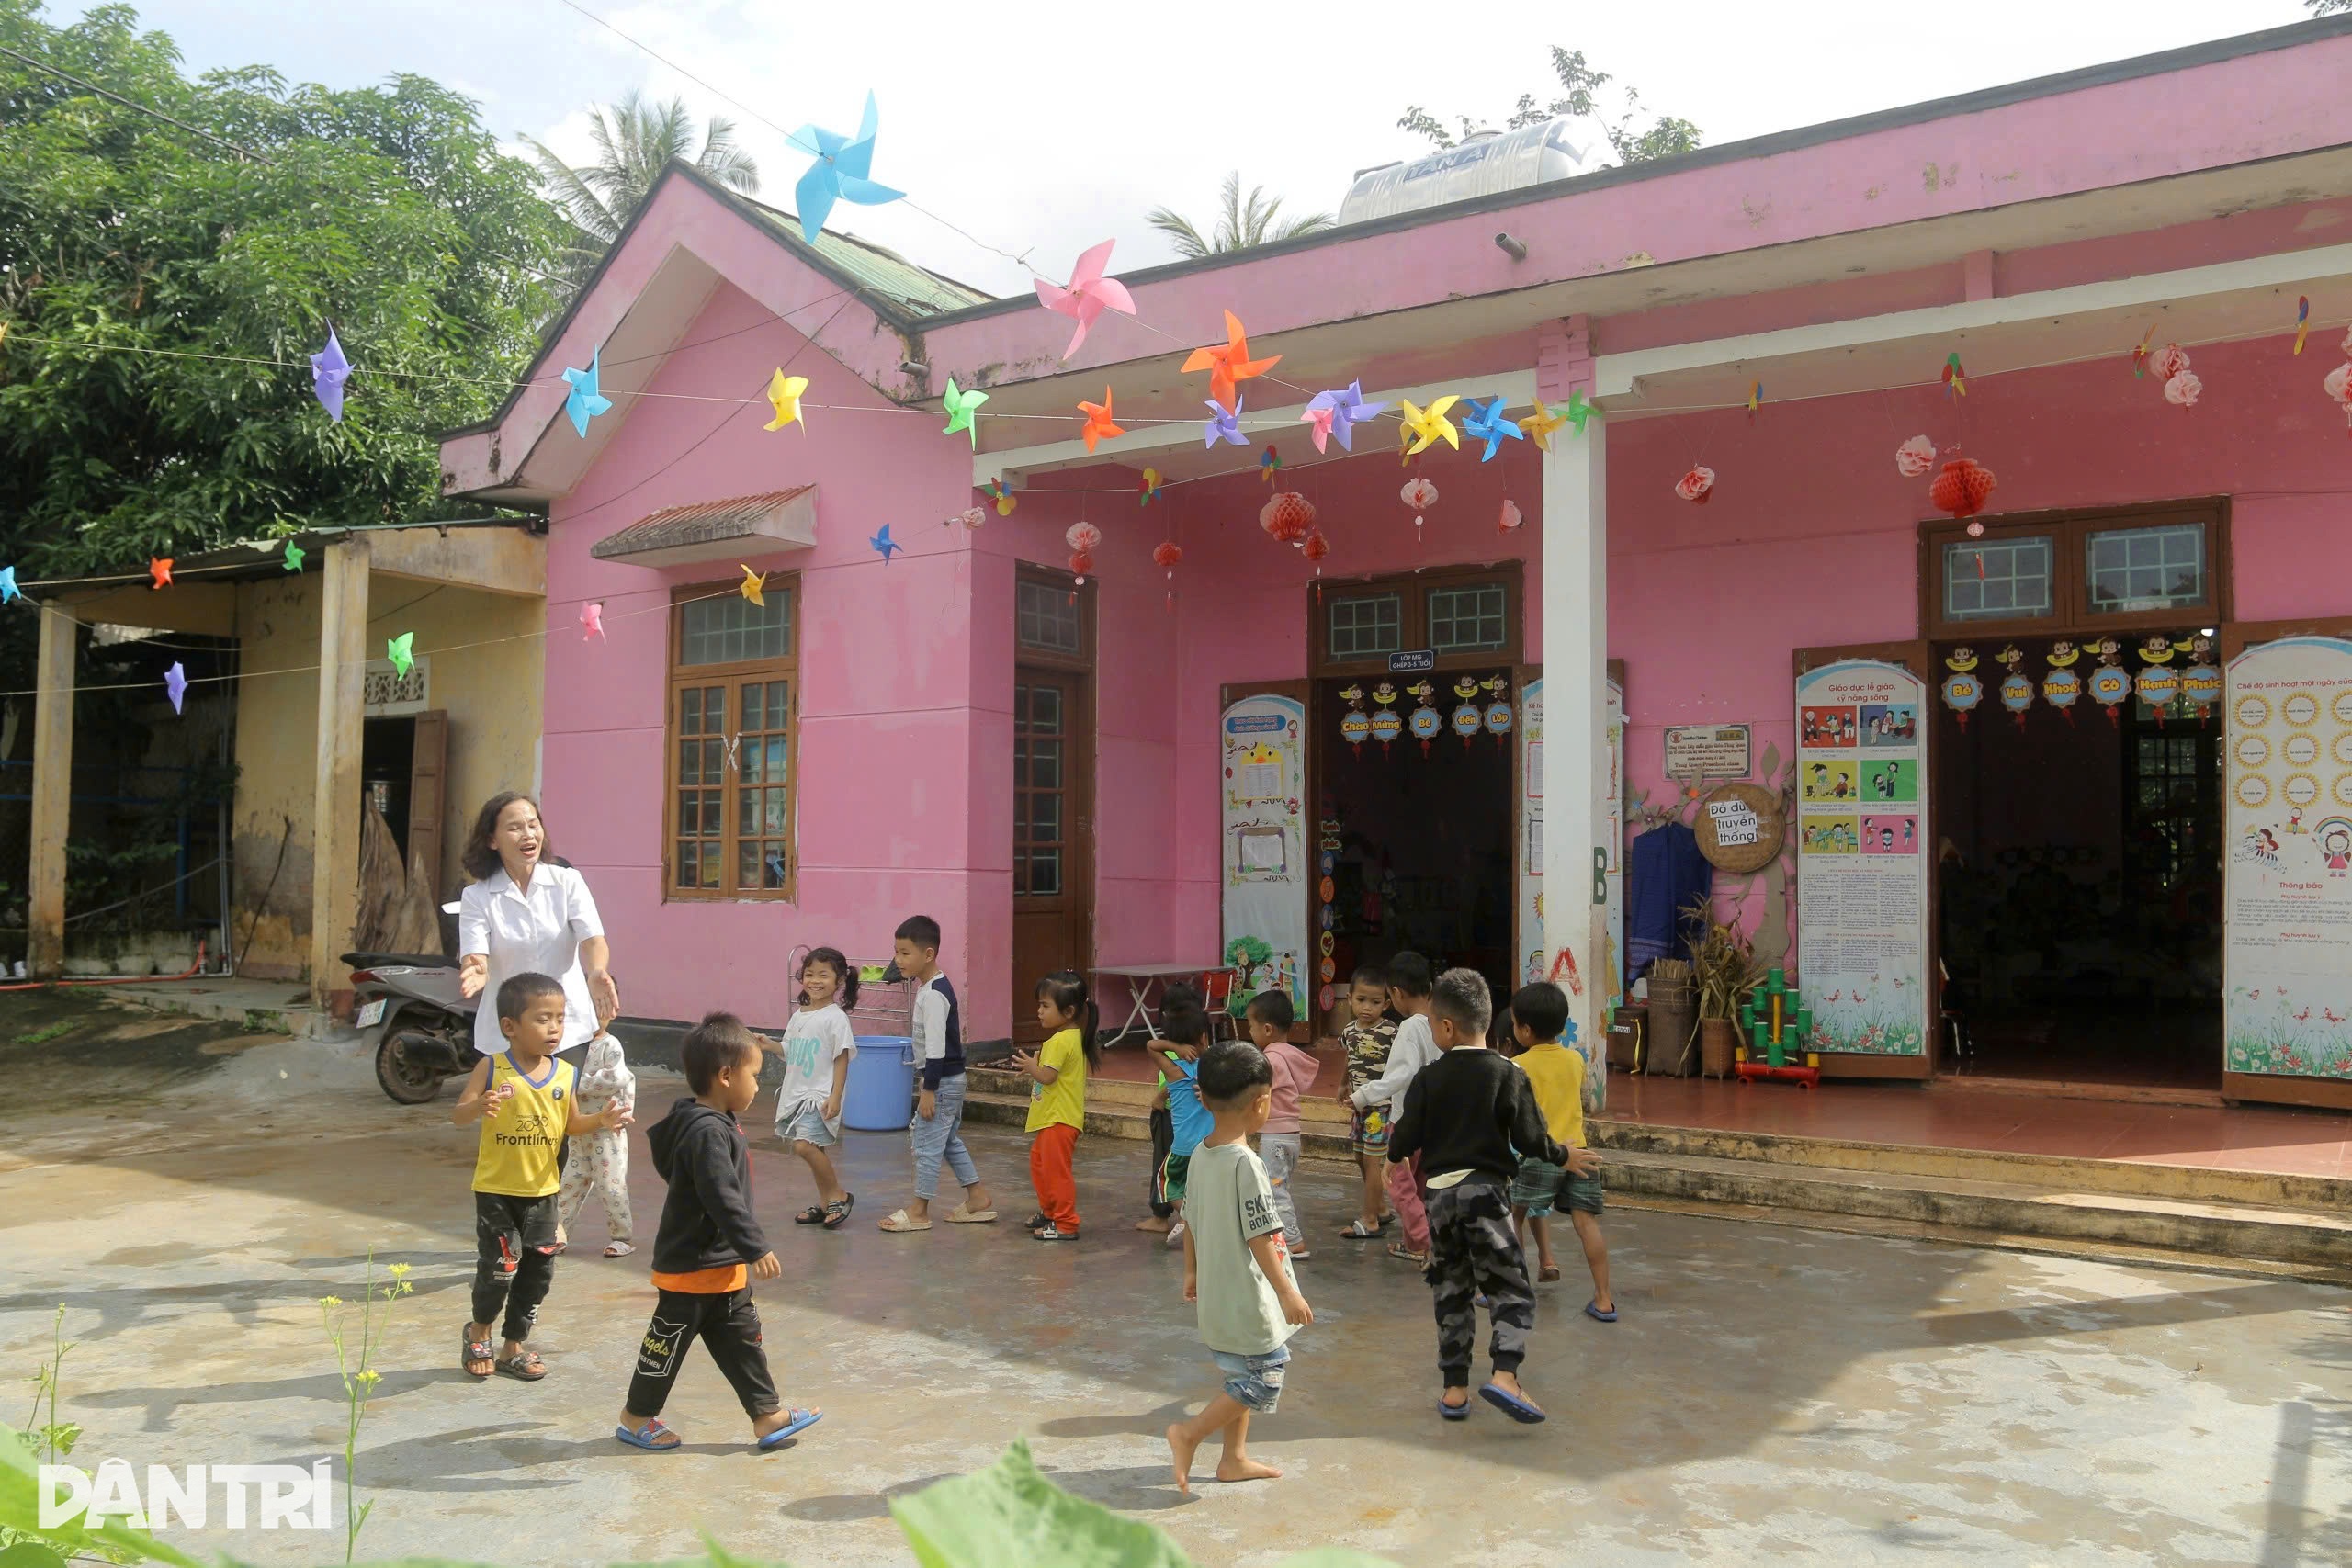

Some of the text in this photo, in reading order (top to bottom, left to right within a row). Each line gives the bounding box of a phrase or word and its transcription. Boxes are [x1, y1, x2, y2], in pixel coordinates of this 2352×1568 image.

[1400, 653, 1411, 661] LỚP
[1828, 681, 1896, 694] Giáo dục lễ giáo,
[1951, 684, 1973, 698] Bé
[2005, 686, 2028, 699] Vui
[2099, 678, 2120, 692] Cô
[2139, 678, 2177, 691] Hạnh
[2182, 676, 2222, 690] Phúc
[2236, 681, 2253, 690] Chế
[2253, 682, 2264, 691] độ
[2265, 681, 2279, 689] sinh
[2280, 680, 2298, 689] hoạt
[2300, 679, 2314, 688] một
[2316, 678, 2336, 687] ngày
[1848, 694, 1868, 703] năng
[1870, 693, 1889, 703] sống
[1342, 712, 1509, 732] Chào Mừng Bé Đến Lớp
[1711, 801, 1726, 815] Đồ
[1717, 814, 1756, 829] truyền
[1719, 829, 1755, 843] thống
[1593, 846, 1608, 905] B
[2279, 881, 2323, 890] Thông báo
[1548, 947, 1583, 997] A
